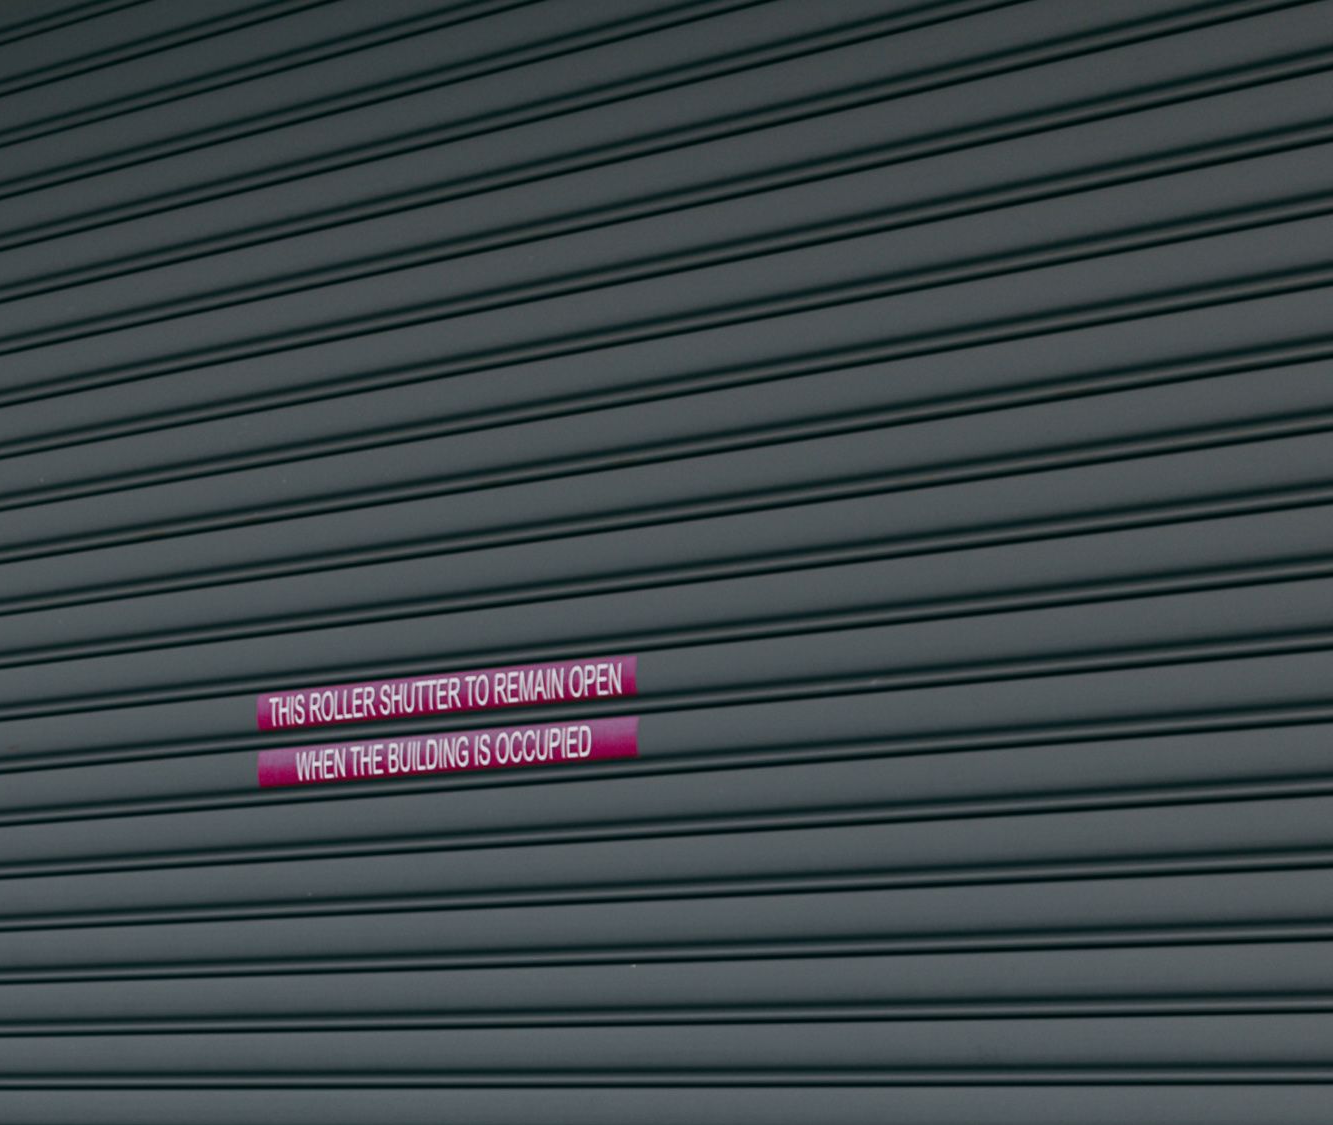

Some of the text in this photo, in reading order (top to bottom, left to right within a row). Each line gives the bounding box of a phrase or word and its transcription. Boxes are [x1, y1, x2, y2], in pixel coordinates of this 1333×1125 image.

[269, 662, 623, 726] THIS ROLLER SHUTTER TO REMAIN OPEN
[295, 725, 593, 781] WHEN THE BUILDING IS OCCUPIED
